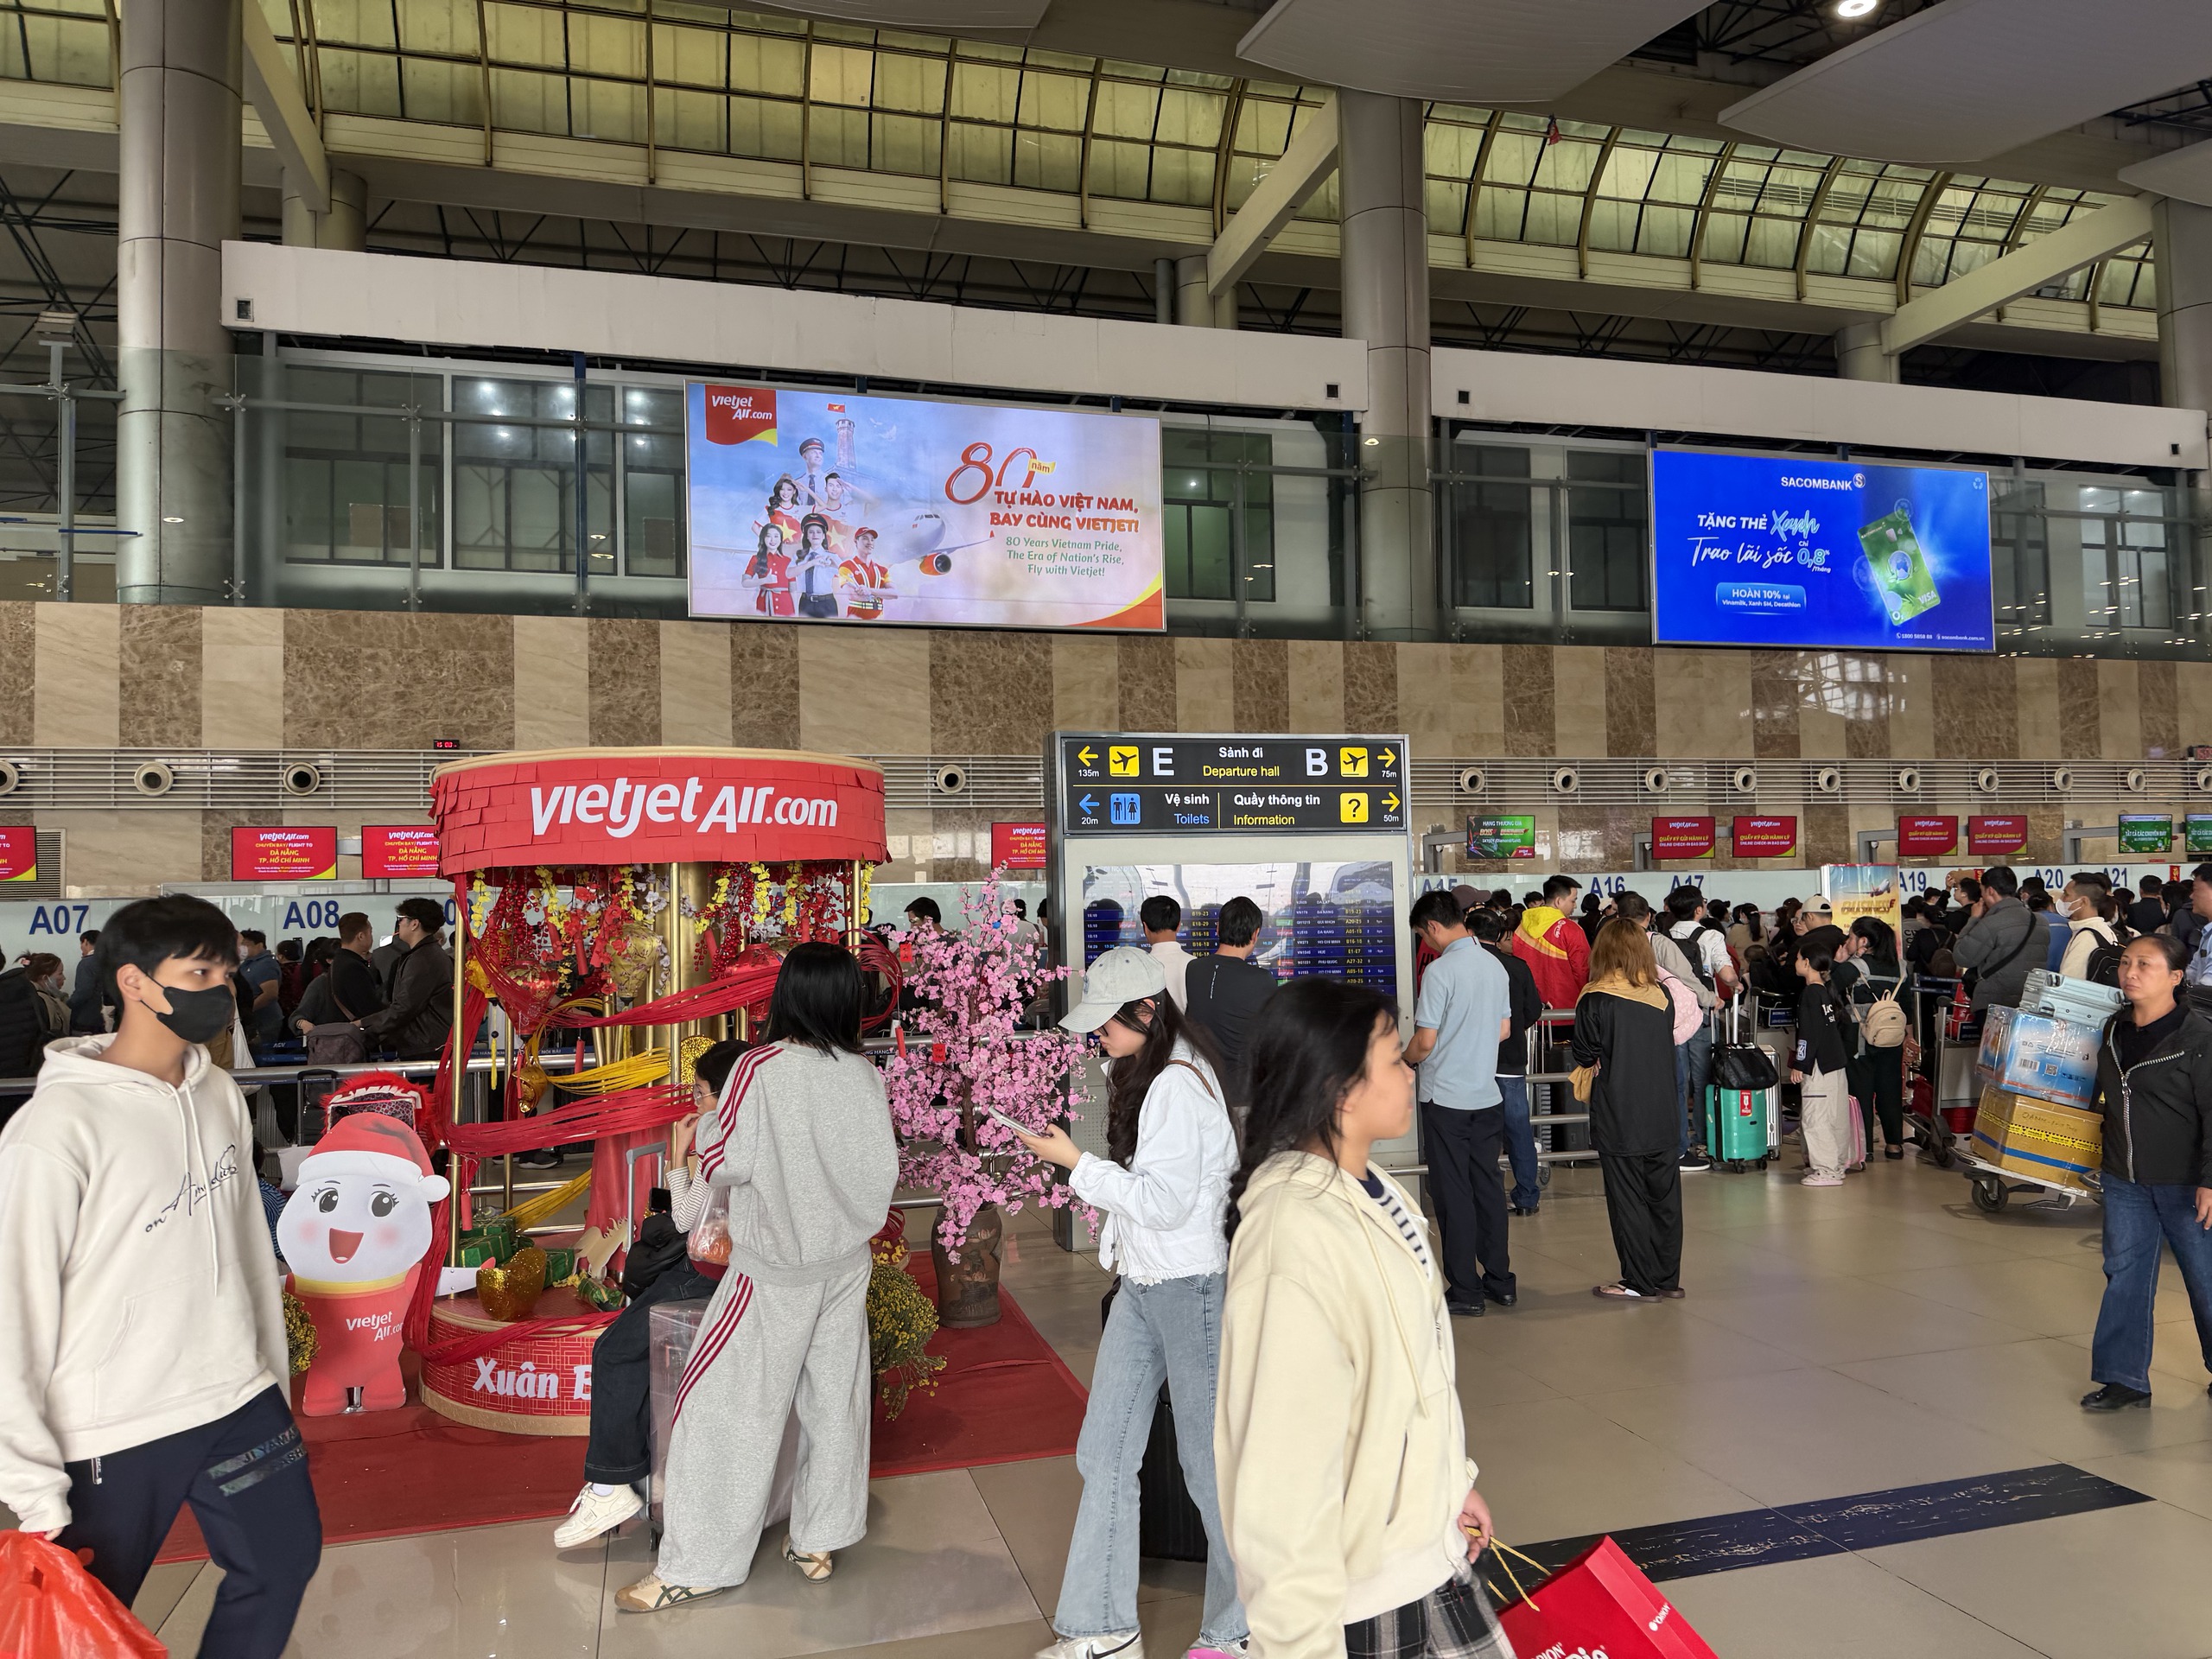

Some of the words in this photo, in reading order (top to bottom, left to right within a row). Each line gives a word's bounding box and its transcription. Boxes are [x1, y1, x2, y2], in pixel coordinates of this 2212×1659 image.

[945, 442, 1038, 505] 80
[1031, 461, 1051, 474] năm
[1781, 476, 1853, 492] SACOMBANK
[994, 490, 1017, 509] TỰ
[1020, 489, 1055, 507] HÀO
[1059, 492, 1093, 512] VIỆT
[1097, 497, 1139, 514] NAM,
[989, 512, 1022, 527] BAY
[1026, 512, 1071, 531] CÙNG
[1075, 517, 1139, 533] VIETJET!
[1697, 512, 1736, 530] TẶNG
[1739, 513, 1768, 531] THẺ
[1770, 509, 1821, 543] Xanh
[1006, 537, 1020, 546] 80
[1024, 537, 1049, 548] Years
[1052, 538, 1091, 550] Vietnam
[1094, 540, 1122, 552] Pride,
[1007, 550, 1025, 560] The
[1027, 551, 1044, 561] Era
[1046, 551, 1058, 563] of
[1102, 554, 1124, 566] Rise,
[1687, 537, 1732, 567] Trao
[1737, 542, 1763, 563] lãi
[1762, 545, 1794, 569] sốc
[1027, 563, 1043, 575] Fly
[1045, 563, 1068, 575] with
[1070, 564, 1105, 576] Vietjet!
[1732, 586, 1761, 599] HOÀN
[1763, 589, 1781, 600] 10%
[1917, 589, 1937, 605] VISA
[1152, 747, 1175, 776] E
[1218, 746, 1249, 759] Sảnh
[1251, 747, 1263, 759] đi
[1306, 748, 1328, 777] B
[1077, 769, 1100, 778] 135m
[1203, 766, 1259, 779] Departure
[1261, 766, 1280, 778] hall
[1381, 770, 1397, 779] 75m
[1165, 793, 1180, 806] Vệ
[1182, 793, 1210, 805] sinh
[1233, 792, 1265, 808] Quầy
[1268, 794, 1305, 808] thông
[1306, 794, 1321, 806] tin
[1081, 817, 1098, 825] 20m
[1174, 813, 1210, 825] Toilets
[1233, 814, 1295, 826] Information
[270, 848, 280, 856] ĐÀ
[1590, 875, 1625, 899] A16
[29, 904, 90, 936] A07
[283, 900, 340, 931] A08
[472, 1356, 559, 1400] Xuân
